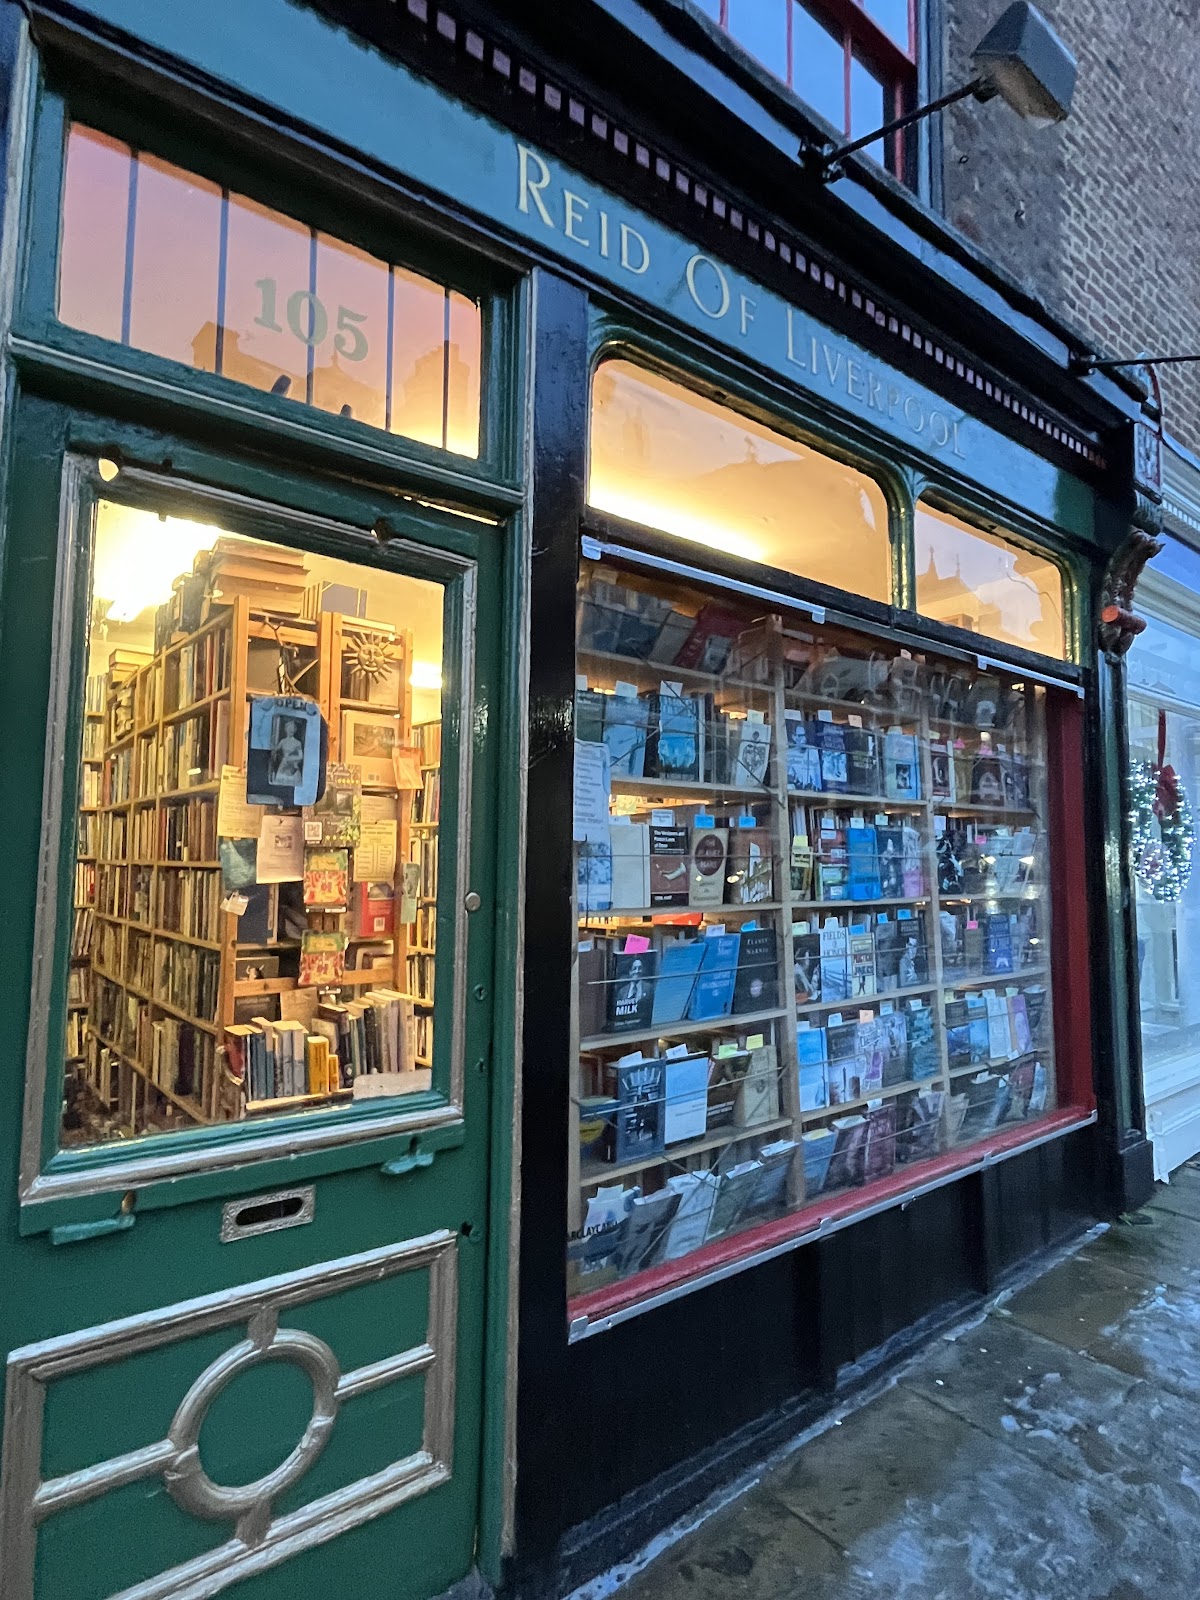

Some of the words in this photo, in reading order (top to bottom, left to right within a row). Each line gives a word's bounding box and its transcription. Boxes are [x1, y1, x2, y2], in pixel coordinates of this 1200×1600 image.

[254, 277, 369, 362] 105
[275, 697, 308, 712] OPEN
[615, 1003, 638, 1016] MILK
